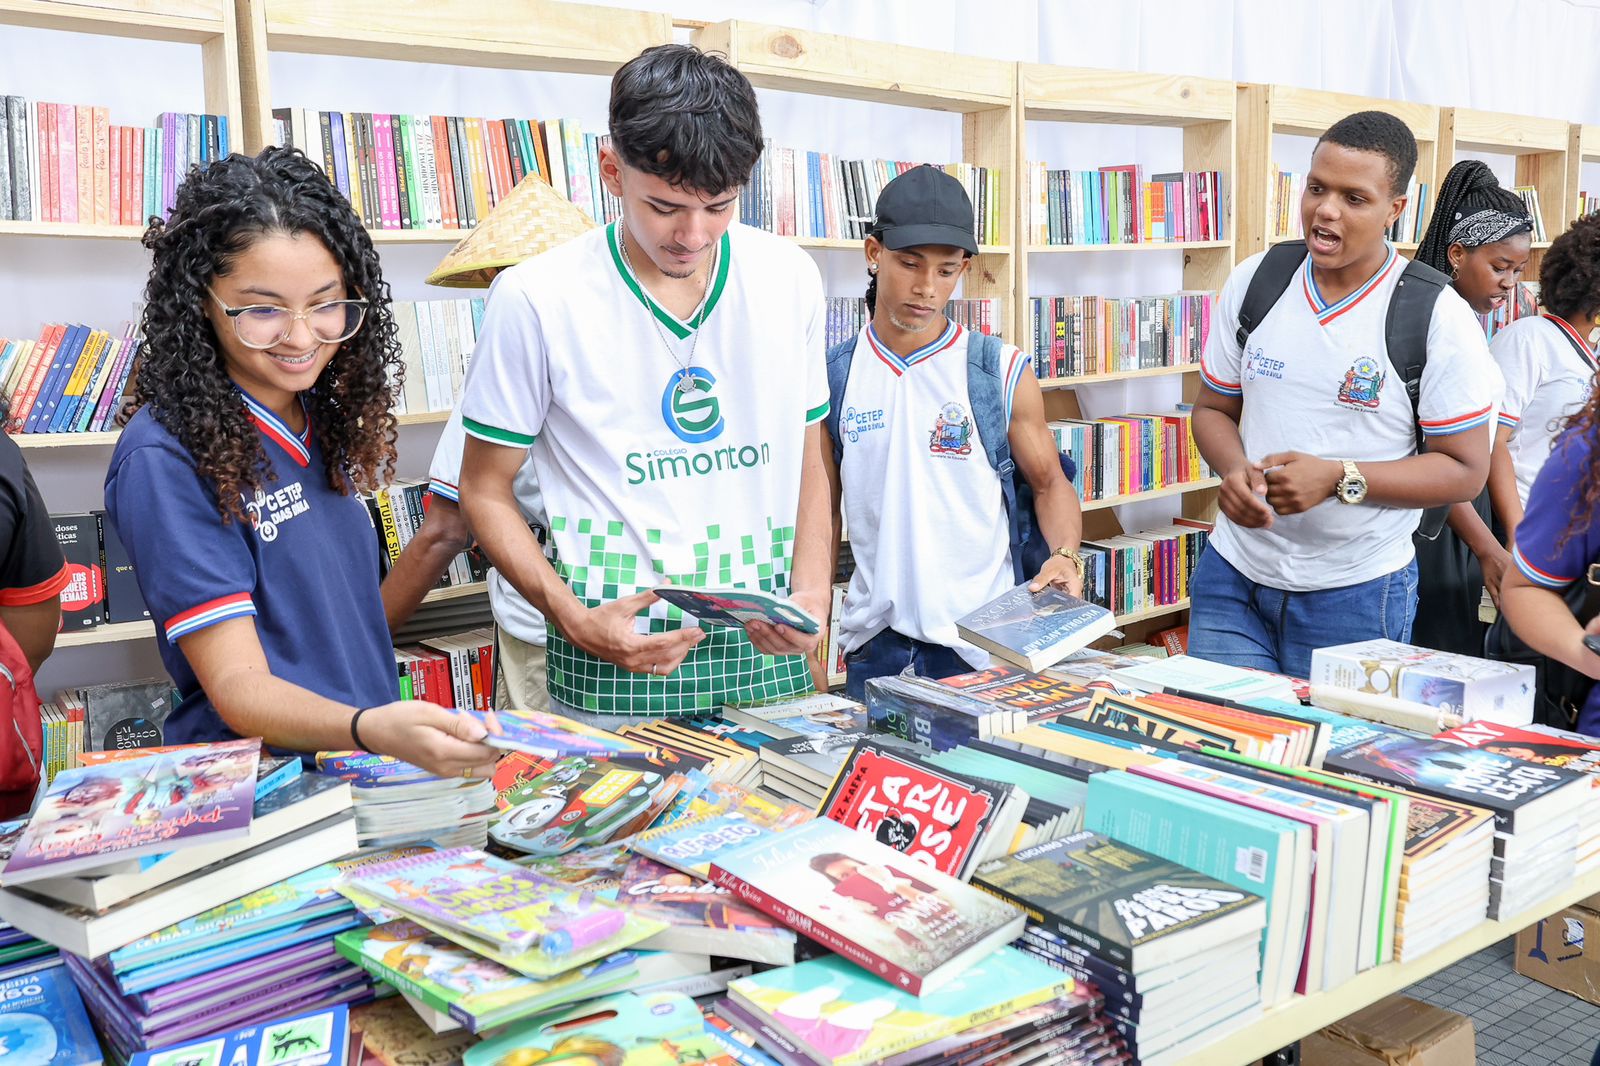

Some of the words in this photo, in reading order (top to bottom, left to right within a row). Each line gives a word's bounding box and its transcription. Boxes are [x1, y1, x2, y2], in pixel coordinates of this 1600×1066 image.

[1259, 357, 1285, 370] CETEP
[856, 409, 884, 424] CETEP
[626, 442, 770, 485] Simonton
[654, 448, 688, 456] COLÉGIO
[266, 482, 302, 511] CETEP
[270, 507, 294, 525] DIAS
[380, 502, 395, 538] TUPAC
[72, 572, 87, 582] TOS
[1062, 609, 1100, 633] VICTORIA
[1022, 630, 1062, 653] AVEYARD
[116, 726, 131, 735] UM
[116, 730, 157, 742] BURACO
[116, 740, 141, 750] COM
[842, 766, 868, 804] KAFKA
[1445, 755, 1514, 793] MORTE
[1481, 765, 1562, 801] LENTA
[661, 824, 758, 858] ALFABETO
[1013, 841, 1063, 860] LUCIANO
[753, 846, 792, 873] Julia
[426, 876, 534, 908] DINOS
[714, 870, 738, 890] Julia
[738, 882, 762, 904] Quinn
[135, 928, 192, 950] LETRAS
[1058, 922, 1082, 942] LUCIANO
[1048, 940, 1061, 955] SER
[1062, 946, 1085, 967] FELIZ?
